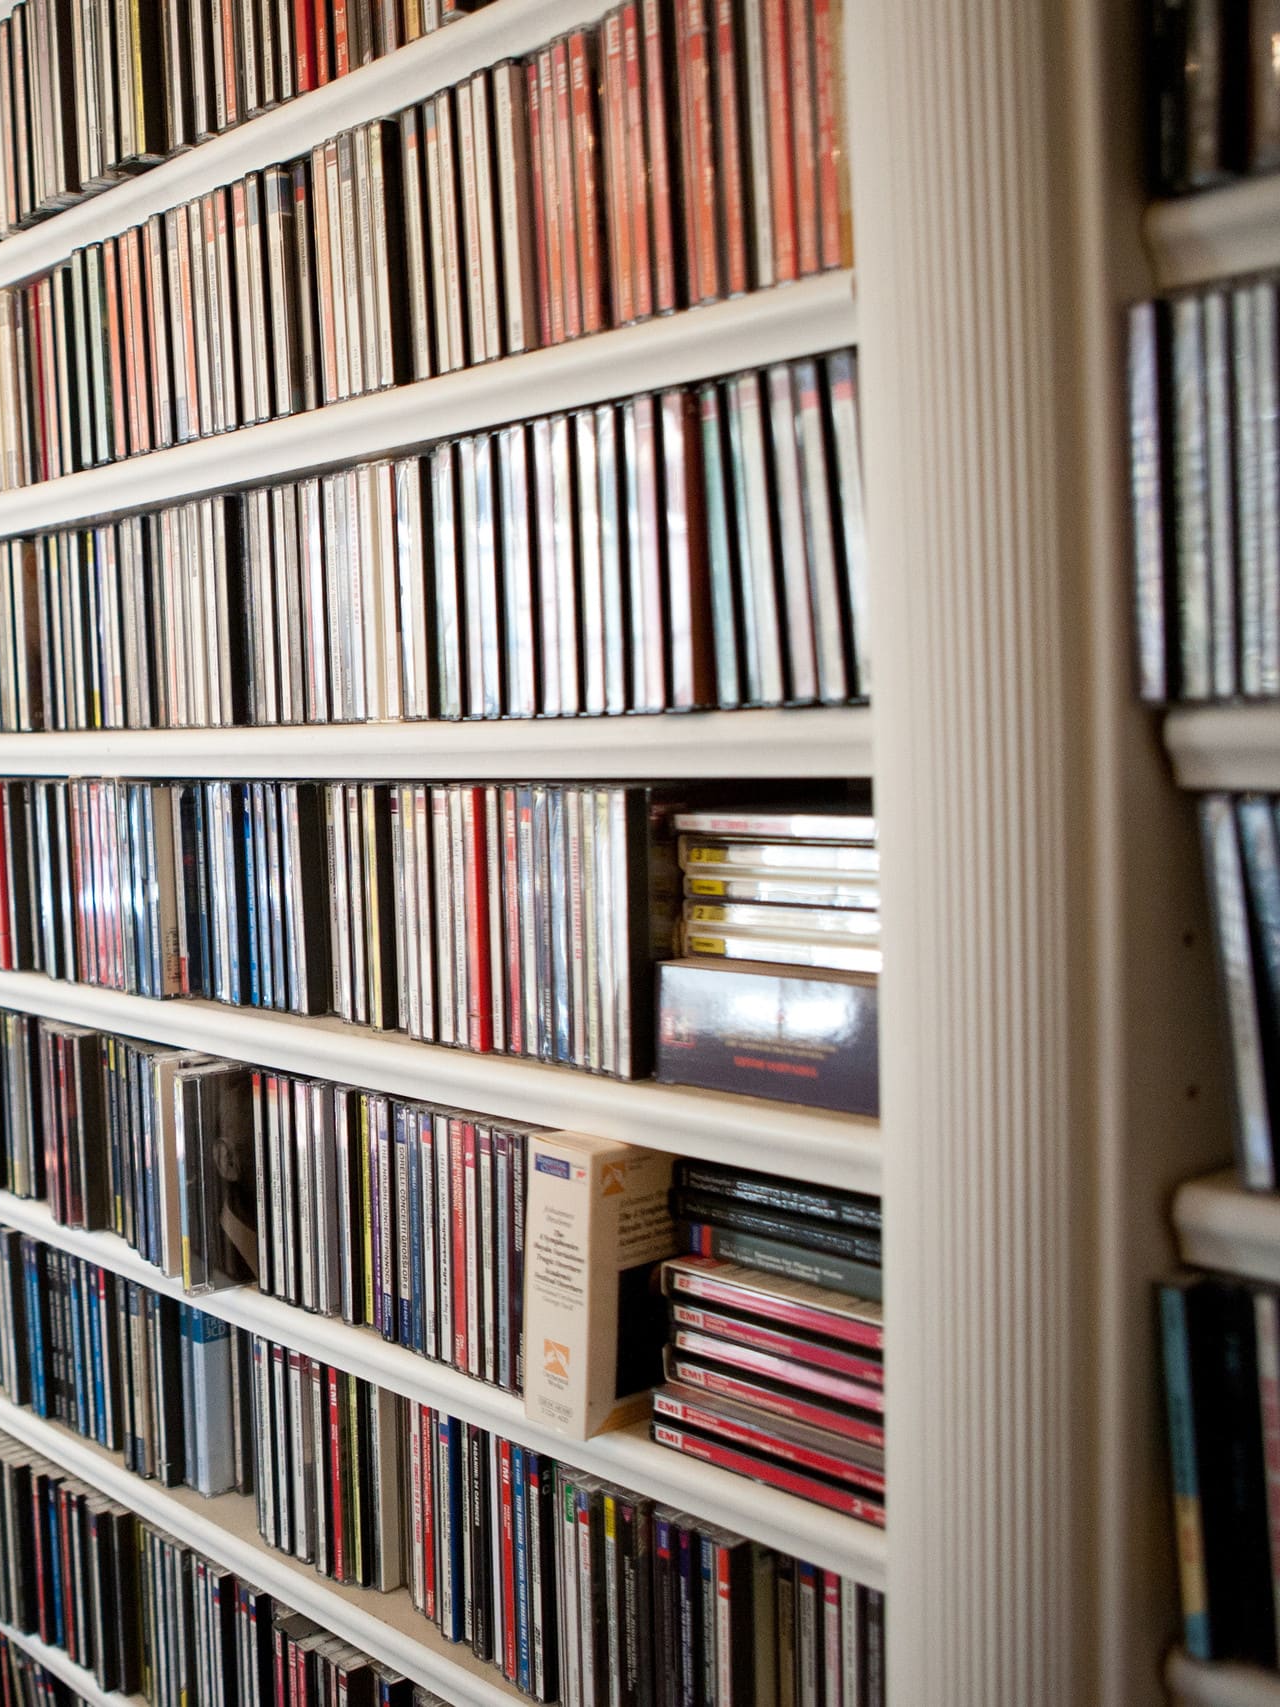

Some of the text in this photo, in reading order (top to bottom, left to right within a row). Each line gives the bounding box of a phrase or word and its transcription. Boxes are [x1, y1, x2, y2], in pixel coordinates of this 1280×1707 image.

[572, 56, 584, 89] EMI
[398, 1147, 406, 1187] CORELLI:
[381, 1163, 389, 1201] ENGLISH
[399, 1188, 407, 1234] CONCERTI
[678, 1310, 701, 1323] EMI
[681, 1367, 702, 1380] EMI
[657, 1399, 679, 1414] EMI
[657, 1428, 679, 1444] EMI
[502, 1457, 510, 1485] EMI
[473, 1479, 479, 1489] 24
[851, 1498, 863, 1514] 2
[582, 1531, 590, 1570] Legends
